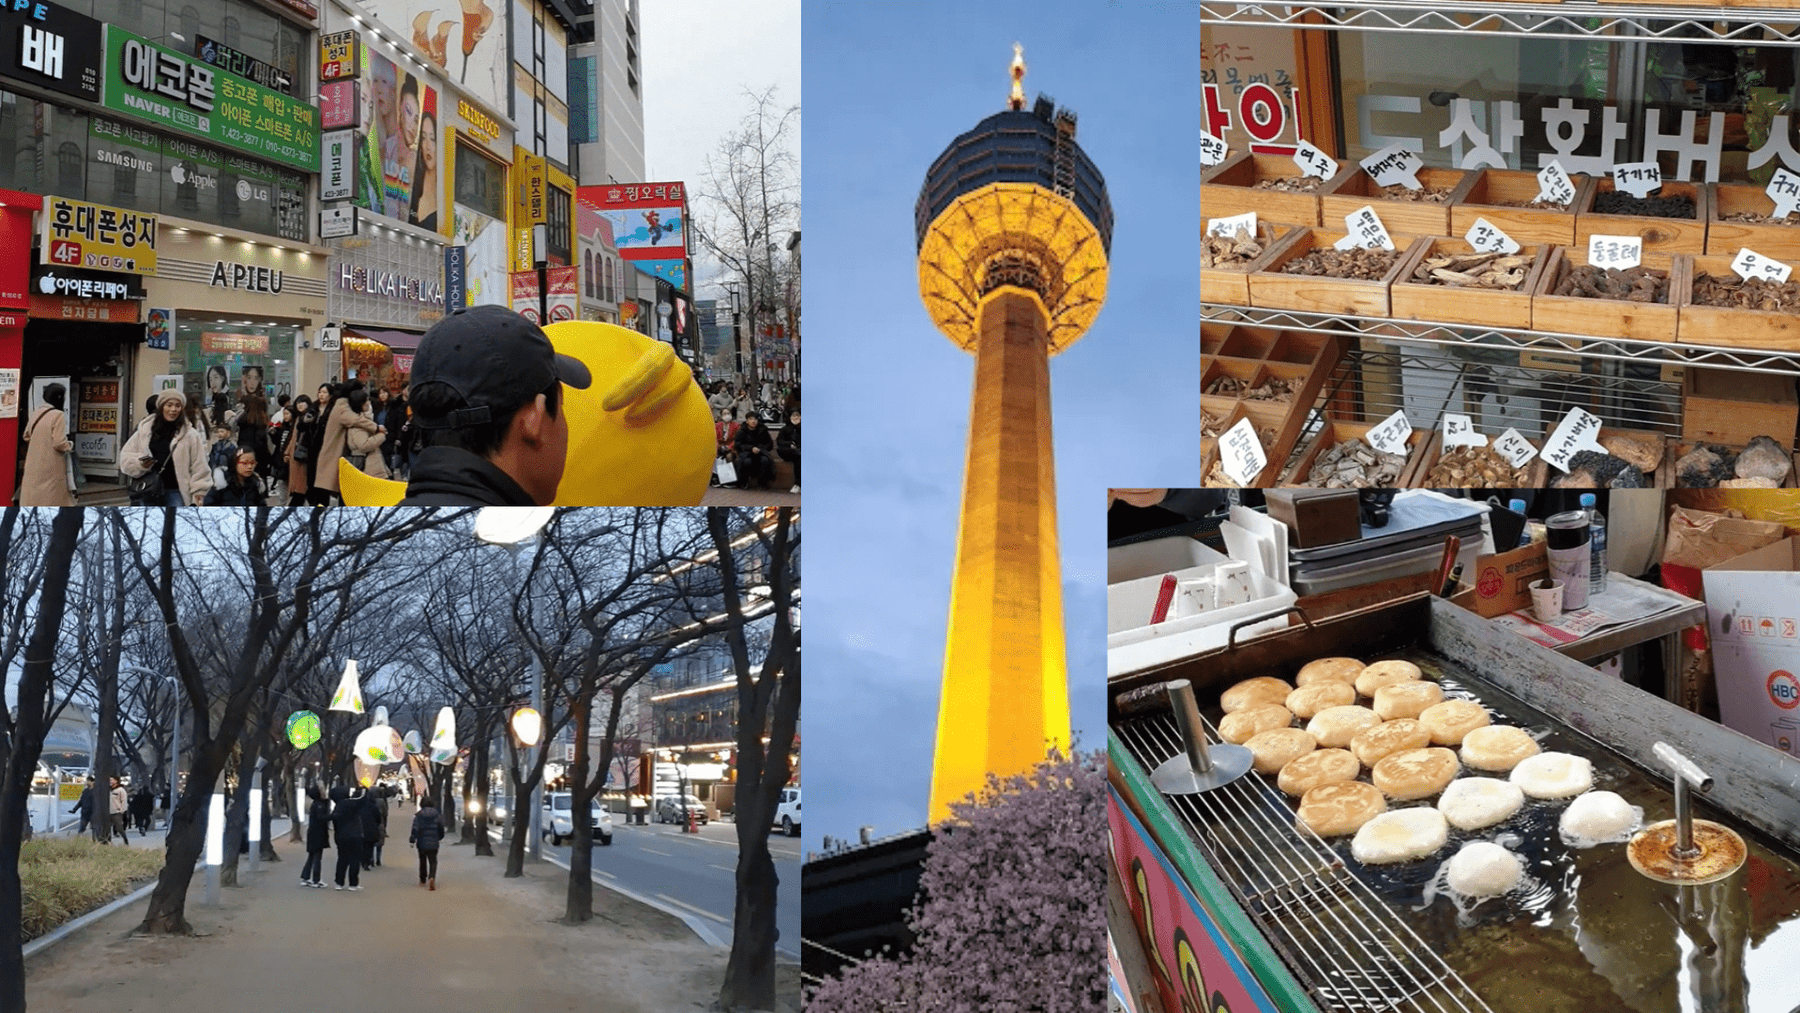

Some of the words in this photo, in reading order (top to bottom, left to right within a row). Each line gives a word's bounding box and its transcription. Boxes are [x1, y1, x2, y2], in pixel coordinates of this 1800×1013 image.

[0, 0, 48, 20] PE
[22, 24, 64, 79] 배
[323, 31, 352, 48] 휴대폰
[329, 45, 347, 60] 성지
[124, 39, 216, 112] 에코폰
[324, 63, 340, 77] 4F
[221, 77, 258, 106] 중고폰
[124, 92, 171, 118] NAVER
[94, 117, 122, 138] 중고폰
[221, 102, 253, 128] 아이폰
[254, 115, 293, 142] 스마트폰
[294, 129, 313, 148] A/S
[97, 149, 153, 173] SAMSUNG
[169, 140, 198, 159] 아이폰
[200, 148, 218, 164] A/S
[1300, 149, 1329, 176] 여주
[1367, 149, 1412, 178] 돼지감자
[331, 142, 342, 187] 에코폰
[1617, 168, 1660, 183] 구기자
[187, 171, 217, 190] Apple
[253, 187, 268, 201] LG
[531, 176, 542, 219] 한스델리
[625, 184, 682, 202] 짱오락실
[52, 200, 156, 250] 휴대폰성지
[54, 242, 79, 263] 4F
[1592, 240, 1639, 262] 둥굴레
[451, 248, 460, 282] HOLIKA
[56, 278, 128, 300] 아이폰리페어
[211, 260, 284, 296] A'PIEU
[340, 262, 396, 297] HOLIKA
[397, 275, 444, 305] HOLIKA
[322, 339, 340, 349] PIEU
[277, 381, 292, 398] 20
[1373, 417, 1410, 450] 유근피
[1550, 412, 1600, 464] 차가버섯
[1771, 684, 1799, 699] HBC
